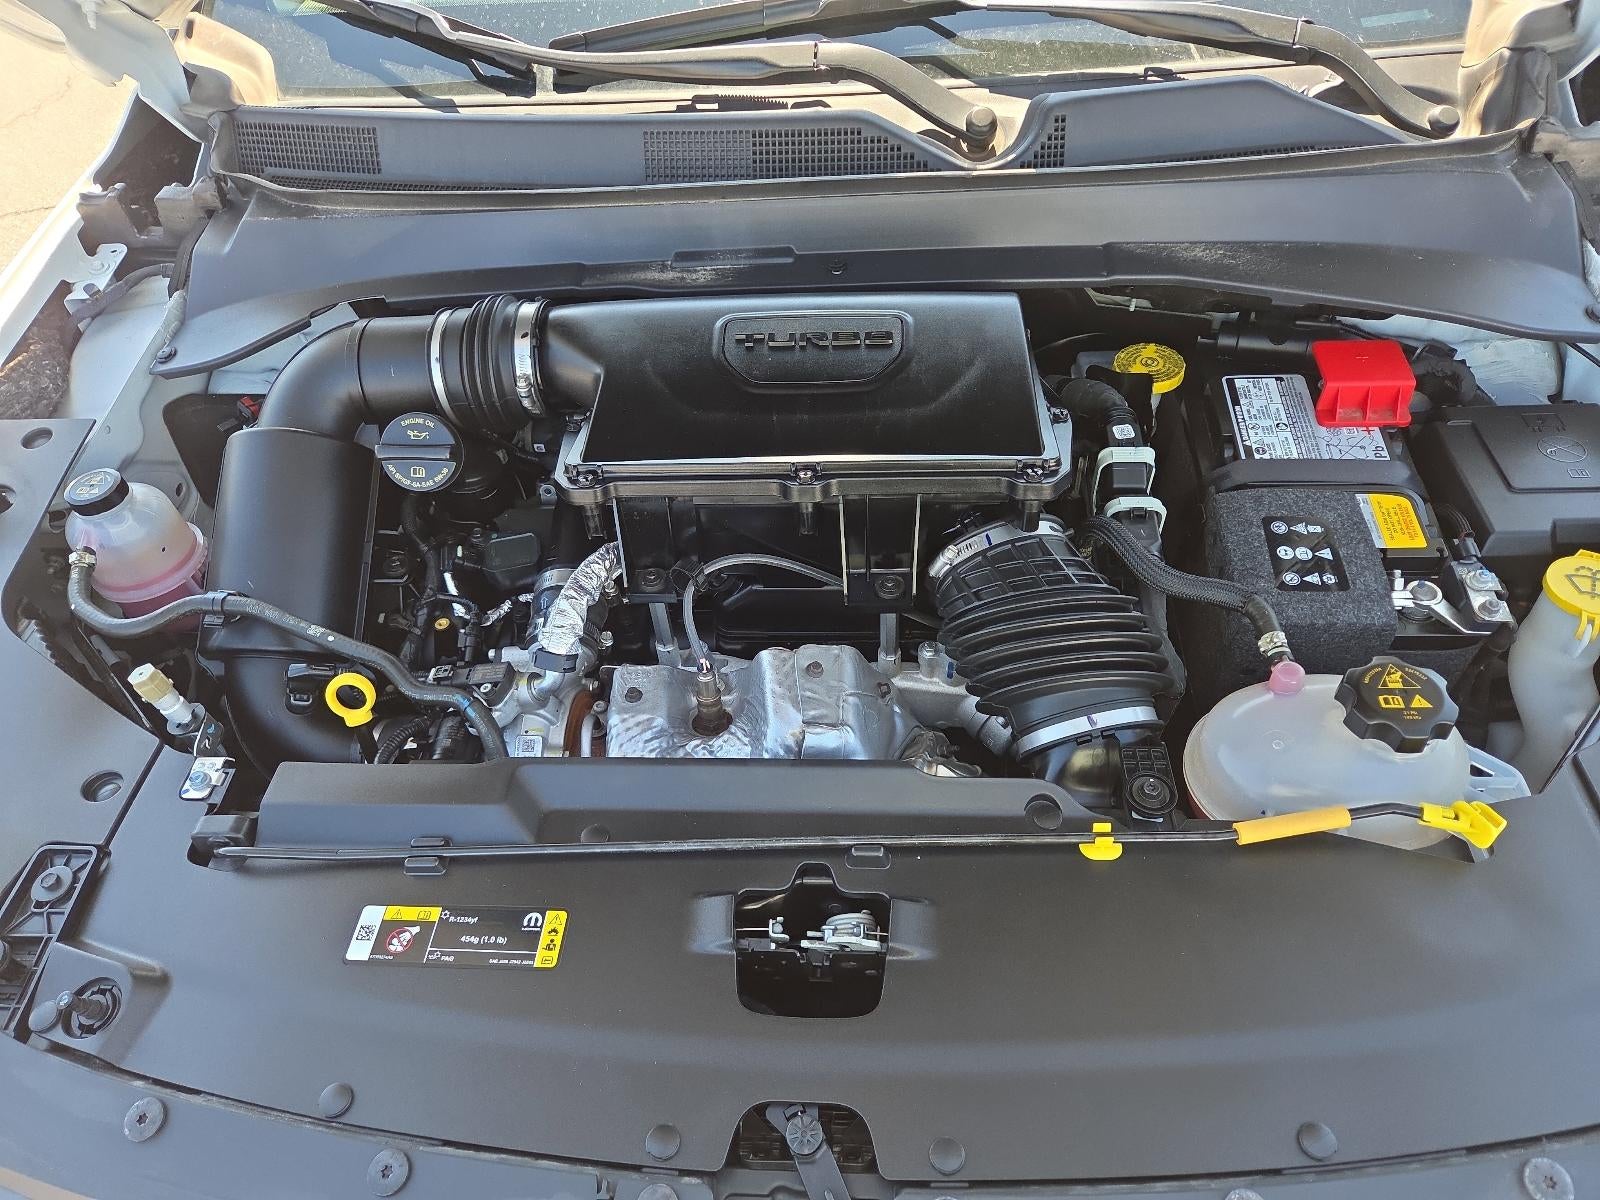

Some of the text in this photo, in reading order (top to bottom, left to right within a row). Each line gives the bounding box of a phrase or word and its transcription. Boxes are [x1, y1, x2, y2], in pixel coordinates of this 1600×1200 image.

[735, 331, 893, 348] TURBO
[401, 418, 435, 429] ENGINE OIL
[1374, 445, 1388, 459] Pb
[387, 464, 396, 474] API
[449, 916, 478, 925] R-1234yf
[460, 936, 508, 945] 454g (1.0 lb)
